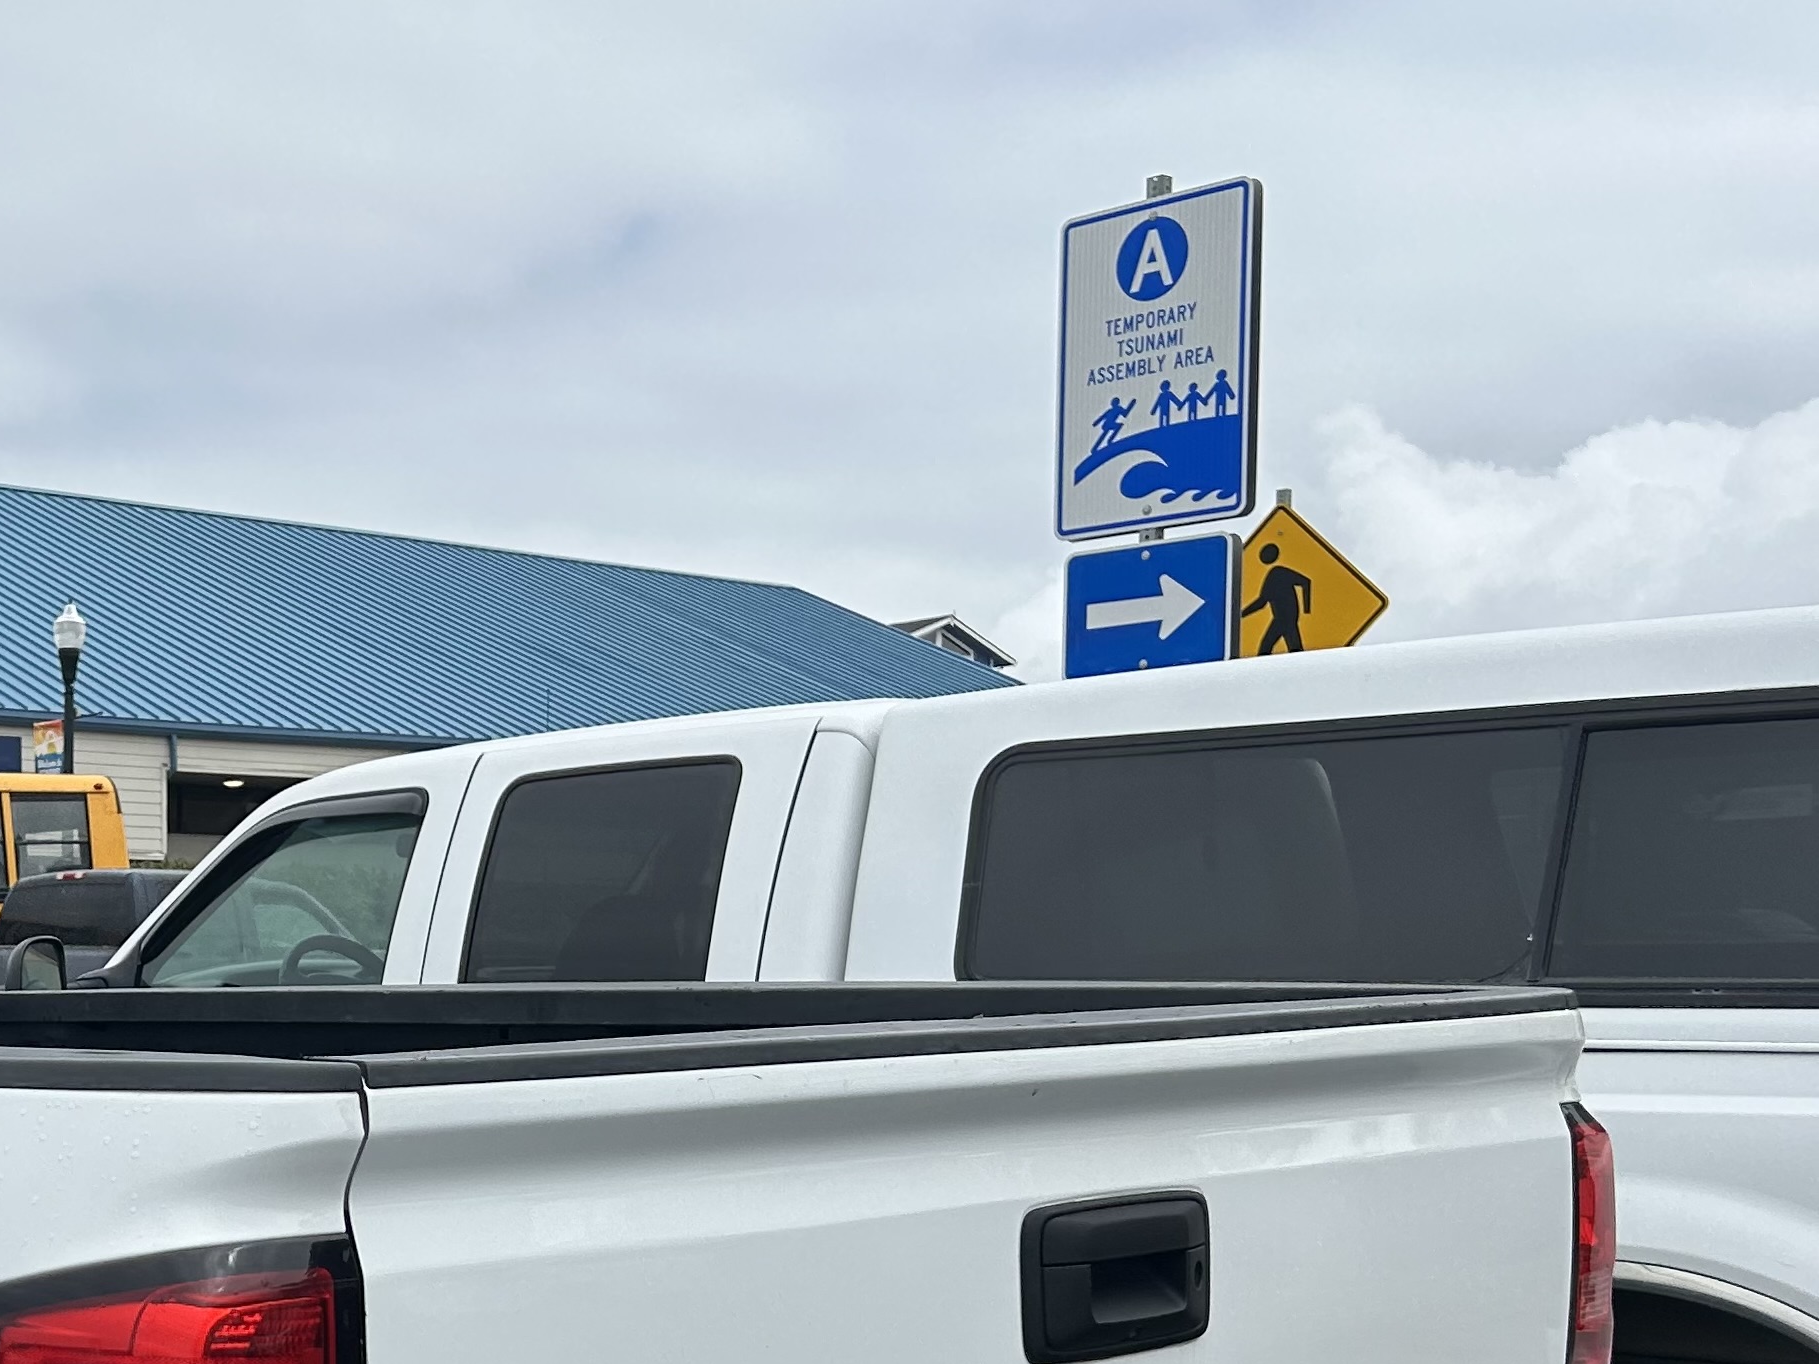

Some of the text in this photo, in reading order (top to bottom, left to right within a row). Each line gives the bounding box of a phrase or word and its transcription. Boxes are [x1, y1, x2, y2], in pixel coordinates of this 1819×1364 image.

[1129, 228, 1174, 294] A
[1105, 302, 1197, 338] TEMPORARY
[1117, 329, 1184, 357] TSUNAMI
[1087, 346, 1214, 386] ASSEMBLY AREA
